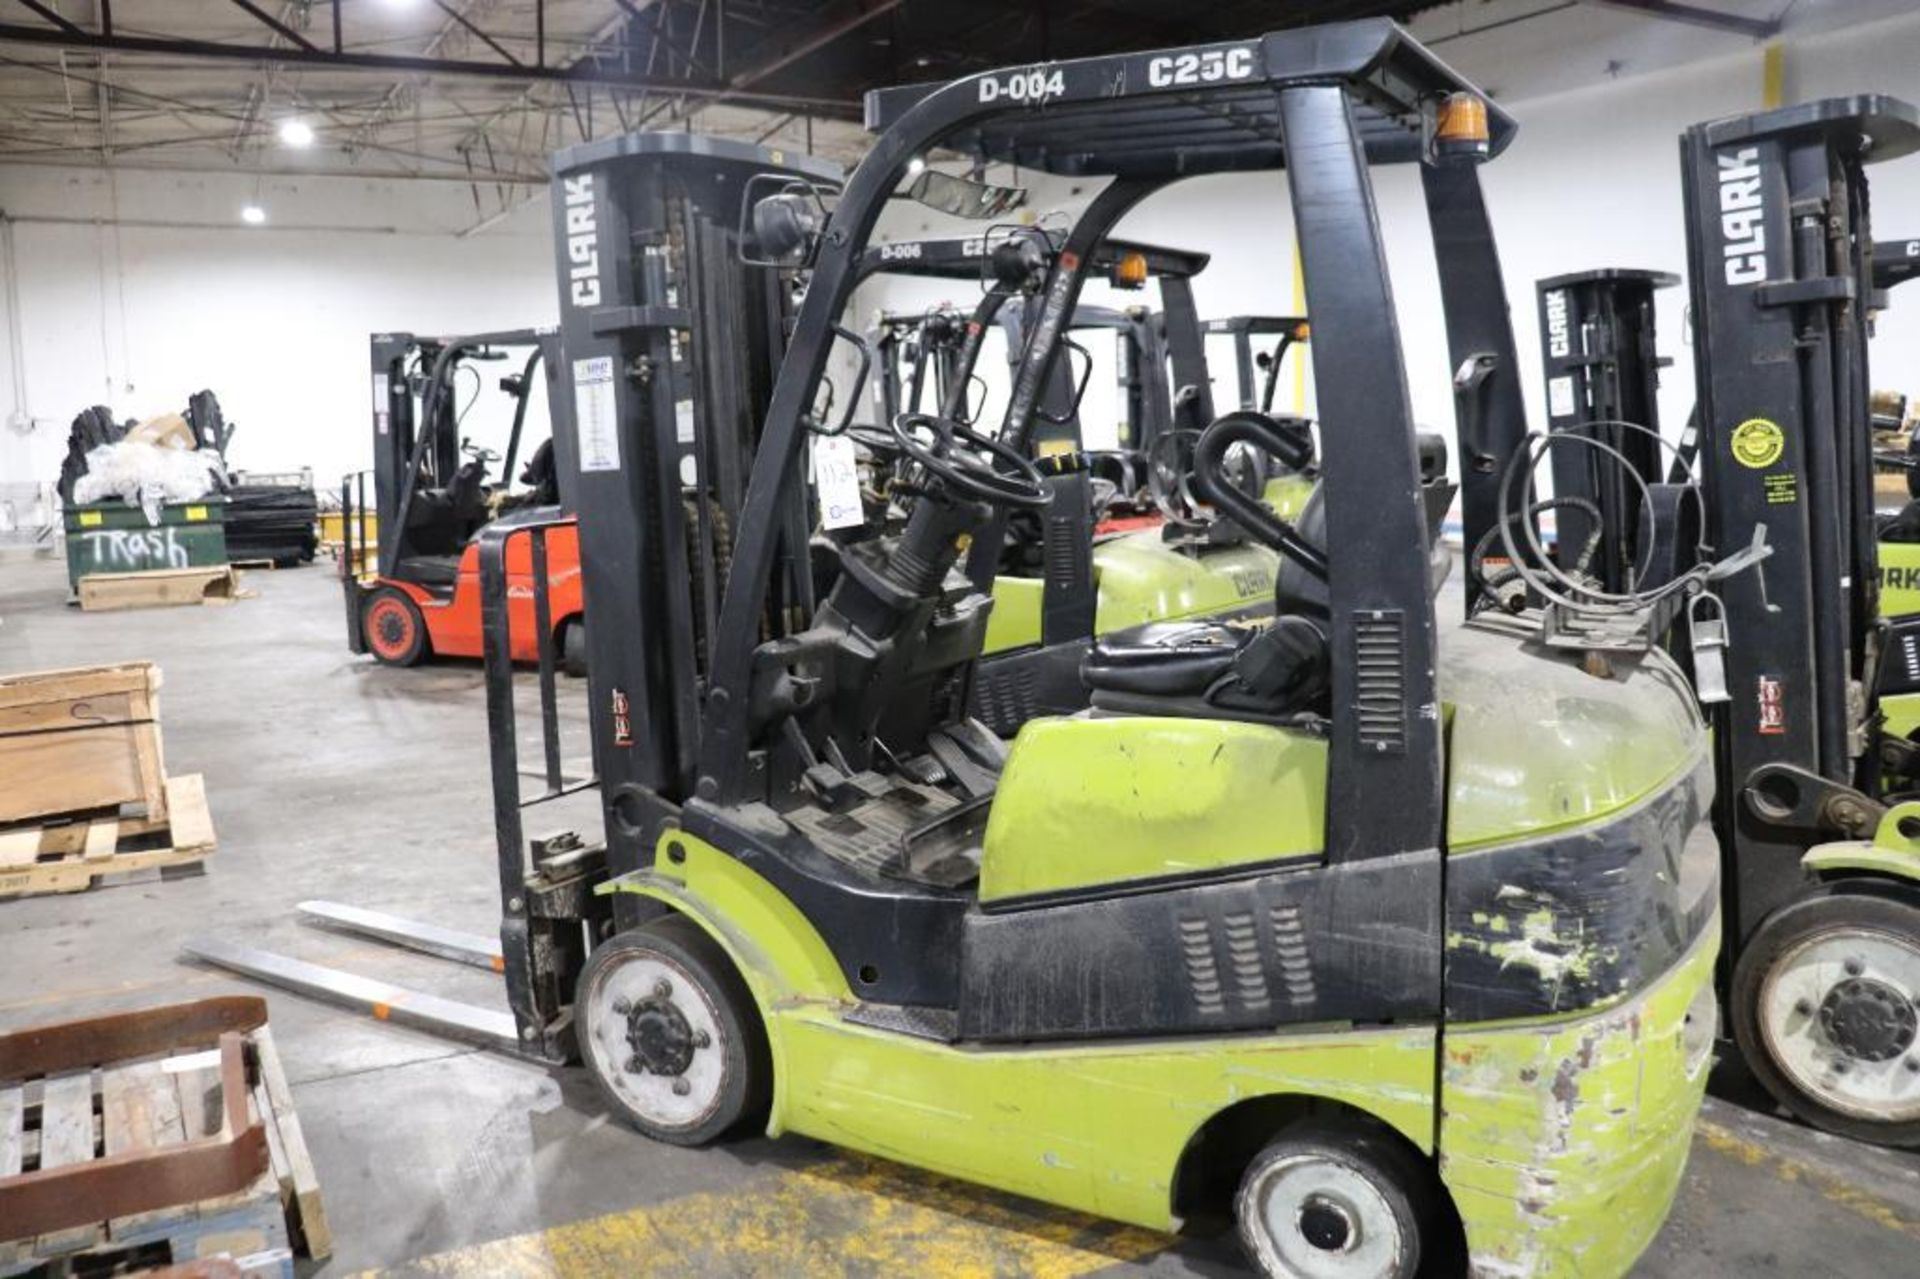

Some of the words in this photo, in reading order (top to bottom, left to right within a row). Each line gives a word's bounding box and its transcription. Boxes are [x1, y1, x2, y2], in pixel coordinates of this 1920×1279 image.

[979, 71, 1065, 102] D-004
[1149, 49, 1252, 87] C25C
[564, 173, 600, 306] CLARK
[1717, 148, 1767, 286] CLARK
[881, 243, 921, 260] D-006
[1545, 288, 1569, 358] CLARK
